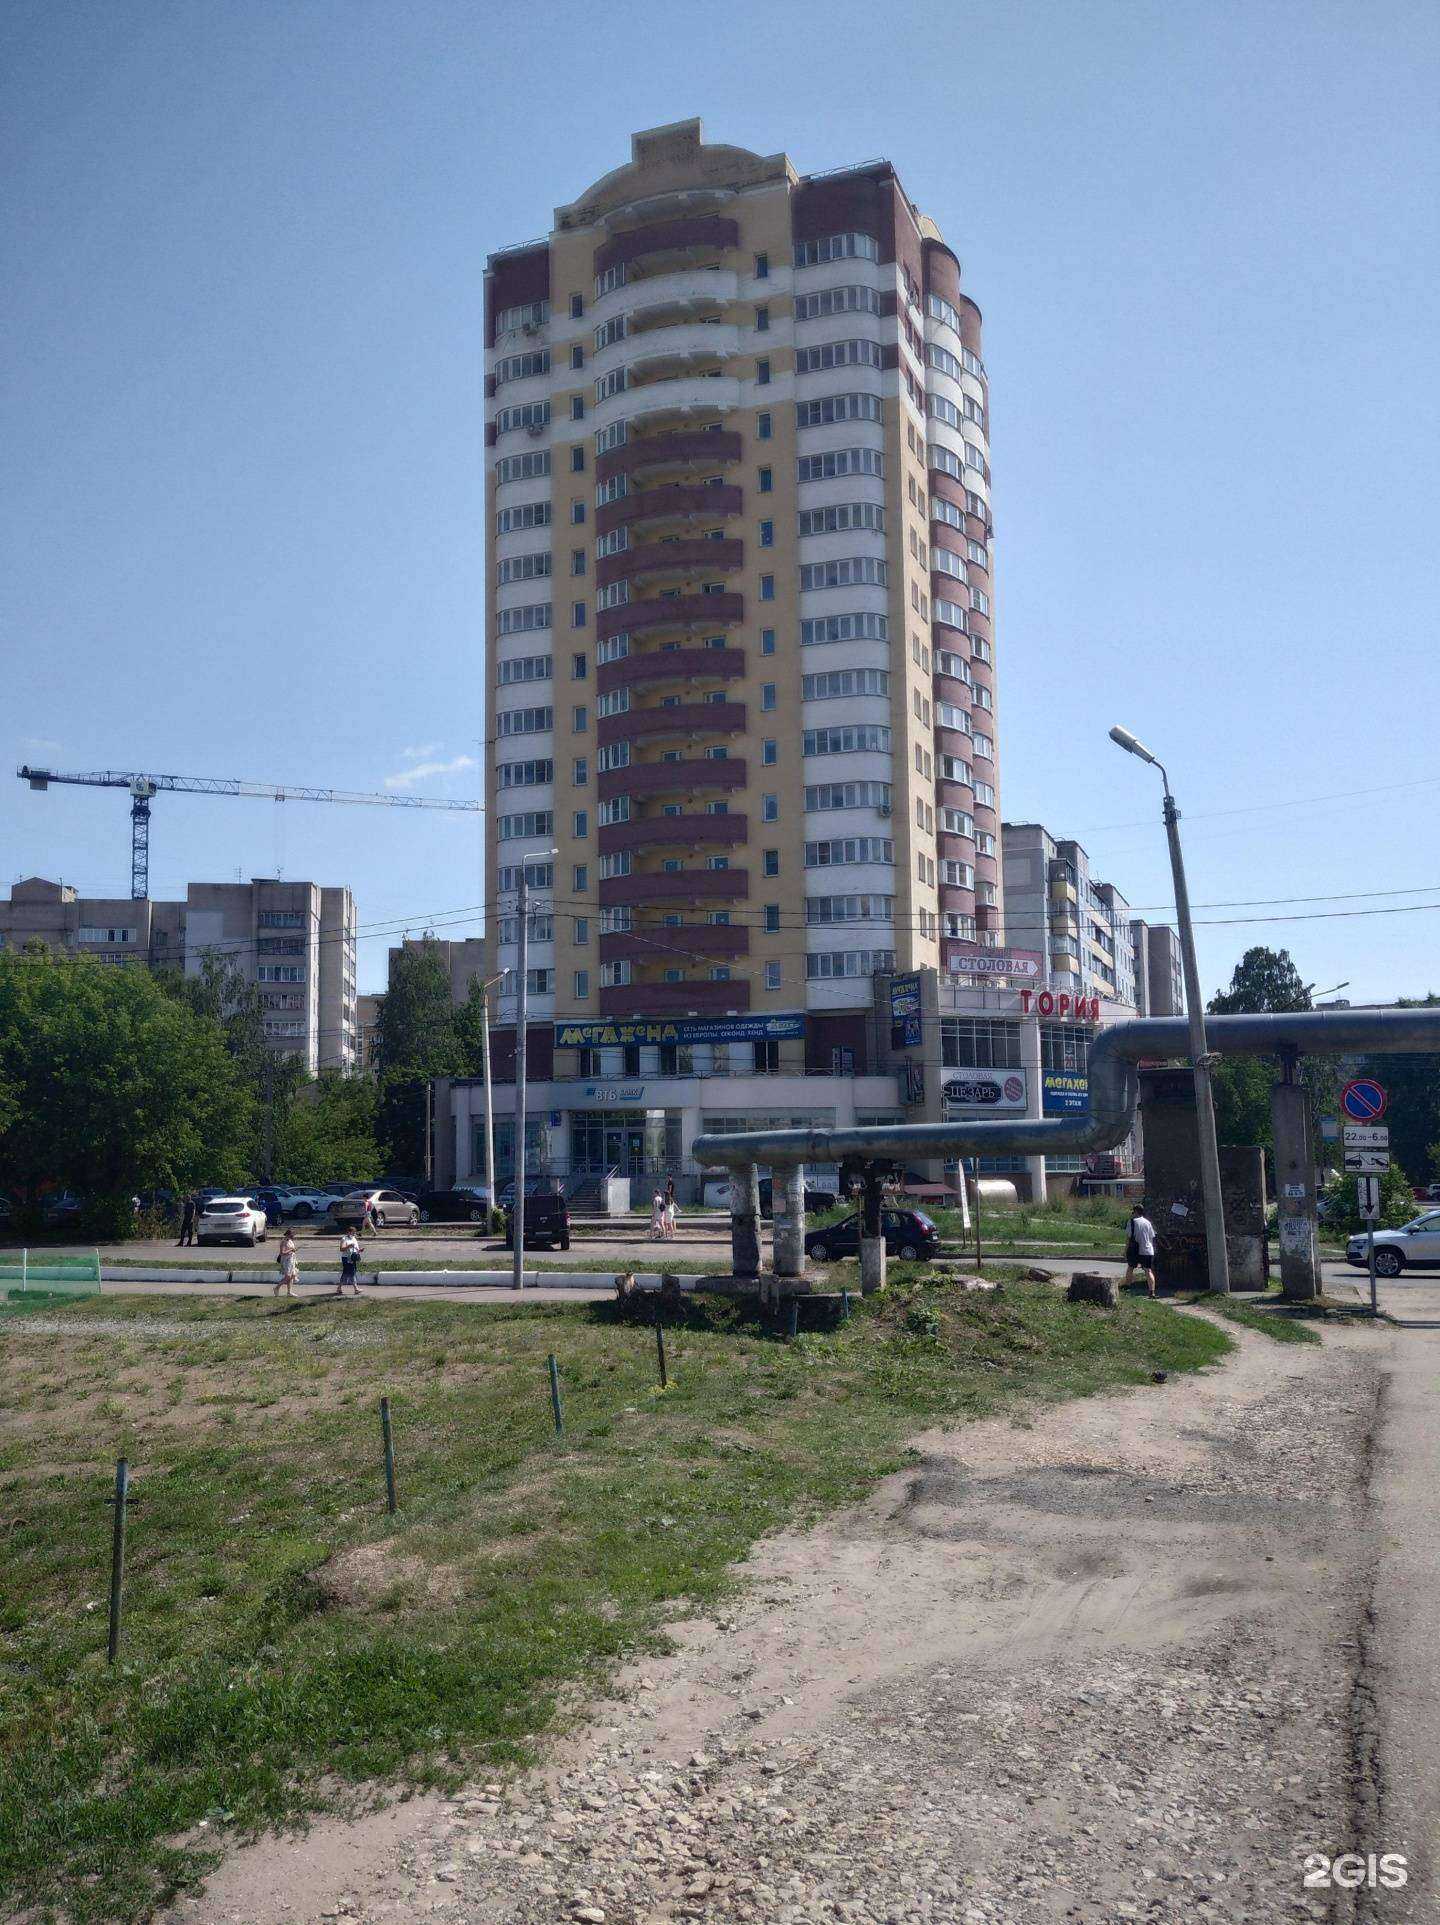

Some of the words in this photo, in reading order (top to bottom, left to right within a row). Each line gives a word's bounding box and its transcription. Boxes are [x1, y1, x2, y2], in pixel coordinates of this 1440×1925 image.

[958, 957, 1029, 974] СТОЛОВАЯ
[1020, 988, 1100, 1021] ТОРИЯ
[698, 1024, 734, 1032] МАГАЗИНОВ
[735, 1022, 764, 1030] ОДЕЖДЫ
[594, 1089, 617, 1102] ВТБ
[950, 1086, 995, 1099] ЦЕЗАРЬ
